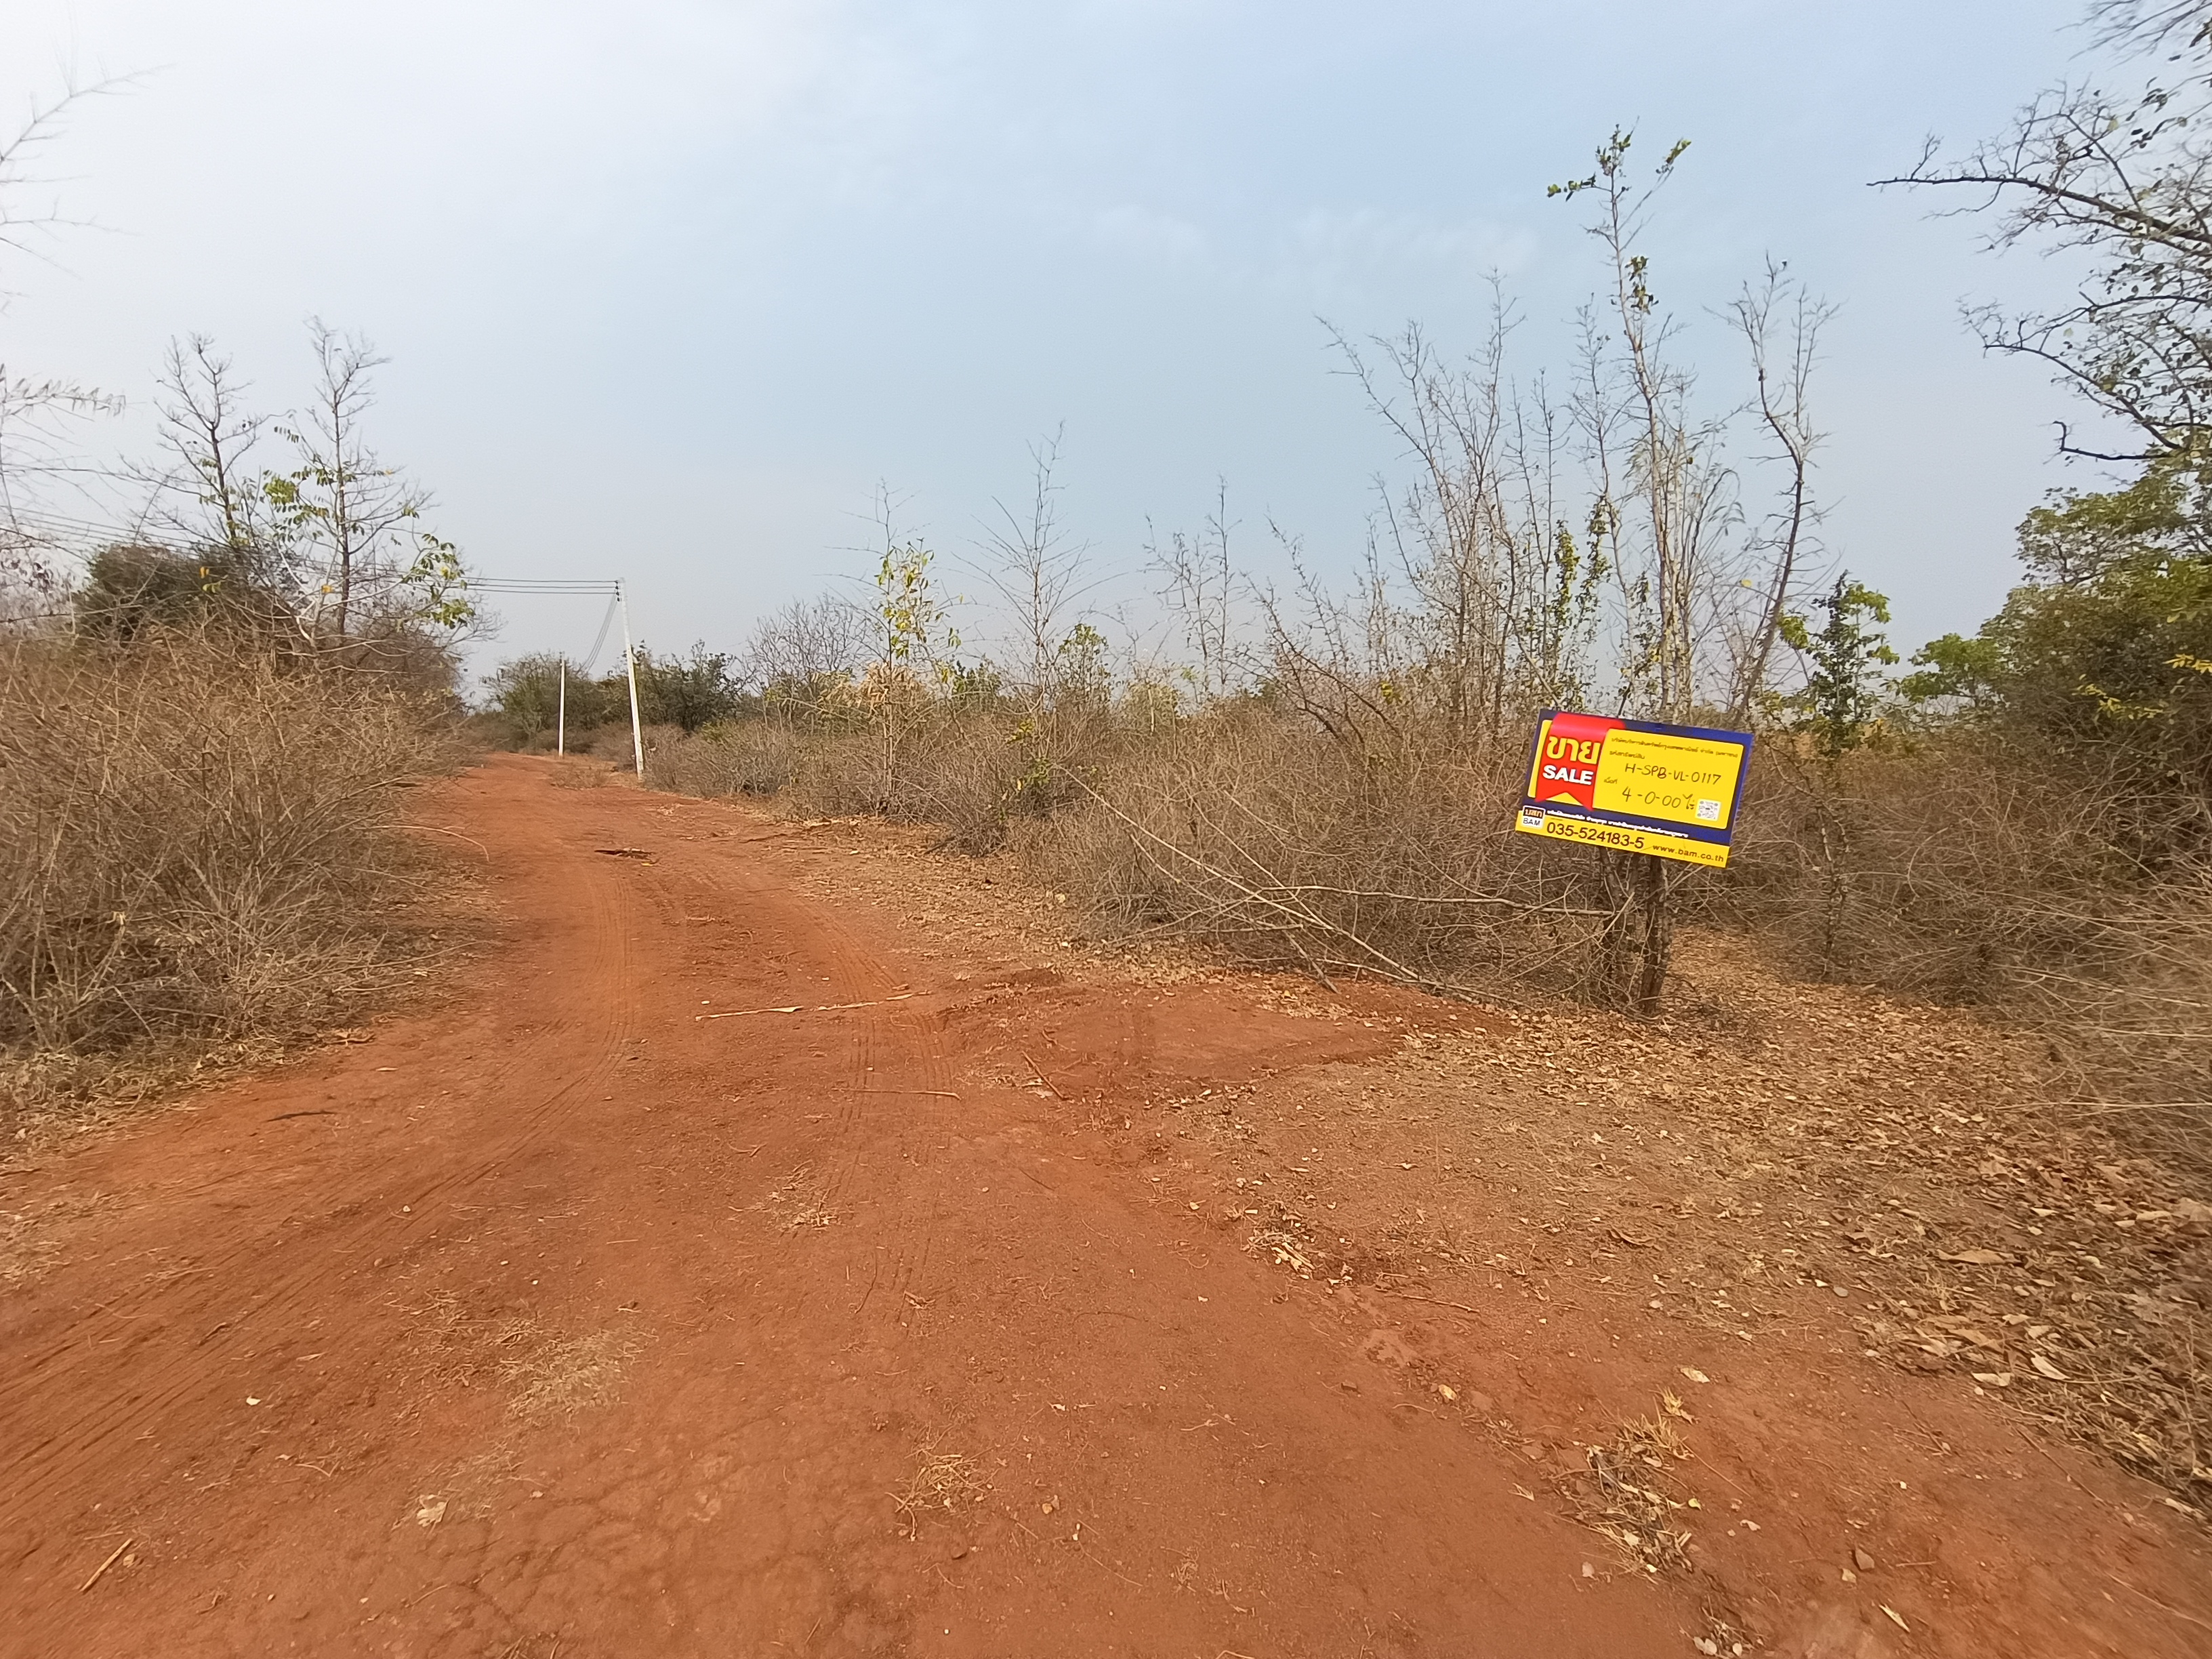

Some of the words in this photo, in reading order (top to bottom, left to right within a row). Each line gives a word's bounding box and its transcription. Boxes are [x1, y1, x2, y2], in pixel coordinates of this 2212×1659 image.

[1547, 736, 1601, 764] ขาย
[1542, 764, 1594, 785] SALE
[1624, 763, 1721, 785] H-SPB-VL-0117
[1523, 817, 1540, 826] BAM
[1547, 821, 1645, 849] 035-524183-5
[1652, 844, 1724, 862] www.bam.co.th
